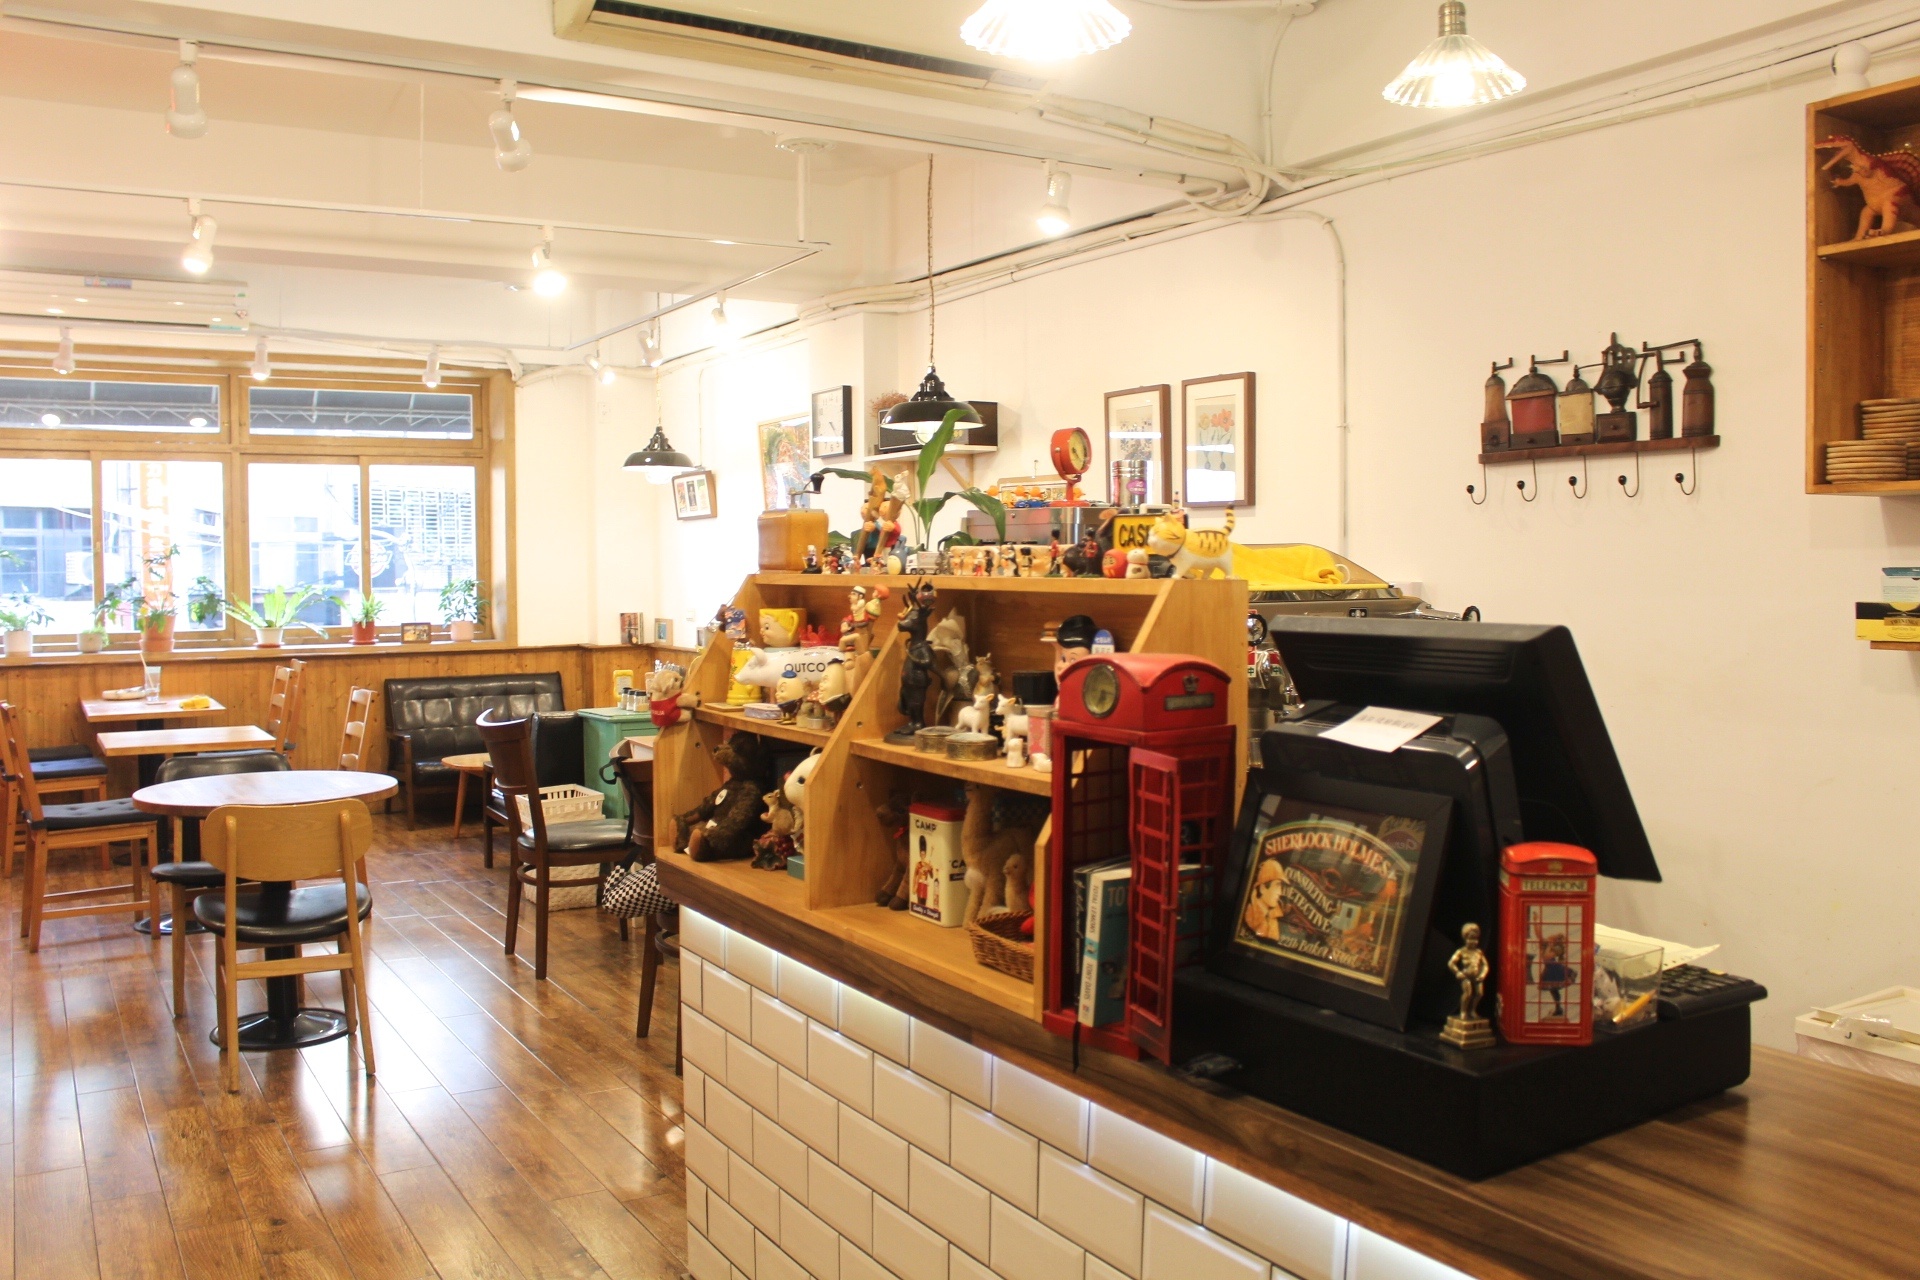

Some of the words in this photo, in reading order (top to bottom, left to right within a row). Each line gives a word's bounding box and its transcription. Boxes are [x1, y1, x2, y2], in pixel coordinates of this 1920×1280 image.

[784, 662, 826, 673] OUTCO
[915, 819, 937, 832] CAMP
[951, 859, 967, 869] CA
[1265, 832, 1335, 856] SHERLOCK
[1334, 835, 1392, 877] HOLMES
[1284, 867, 1334, 914] CONSULTING
[1525, 881, 1585, 890] TELEPHONE
[1107, 886, 1125, 907] TO
[1282, 886, 1331, 932] DETECTIVE
[1297, 939, 1329, 958] Baker
